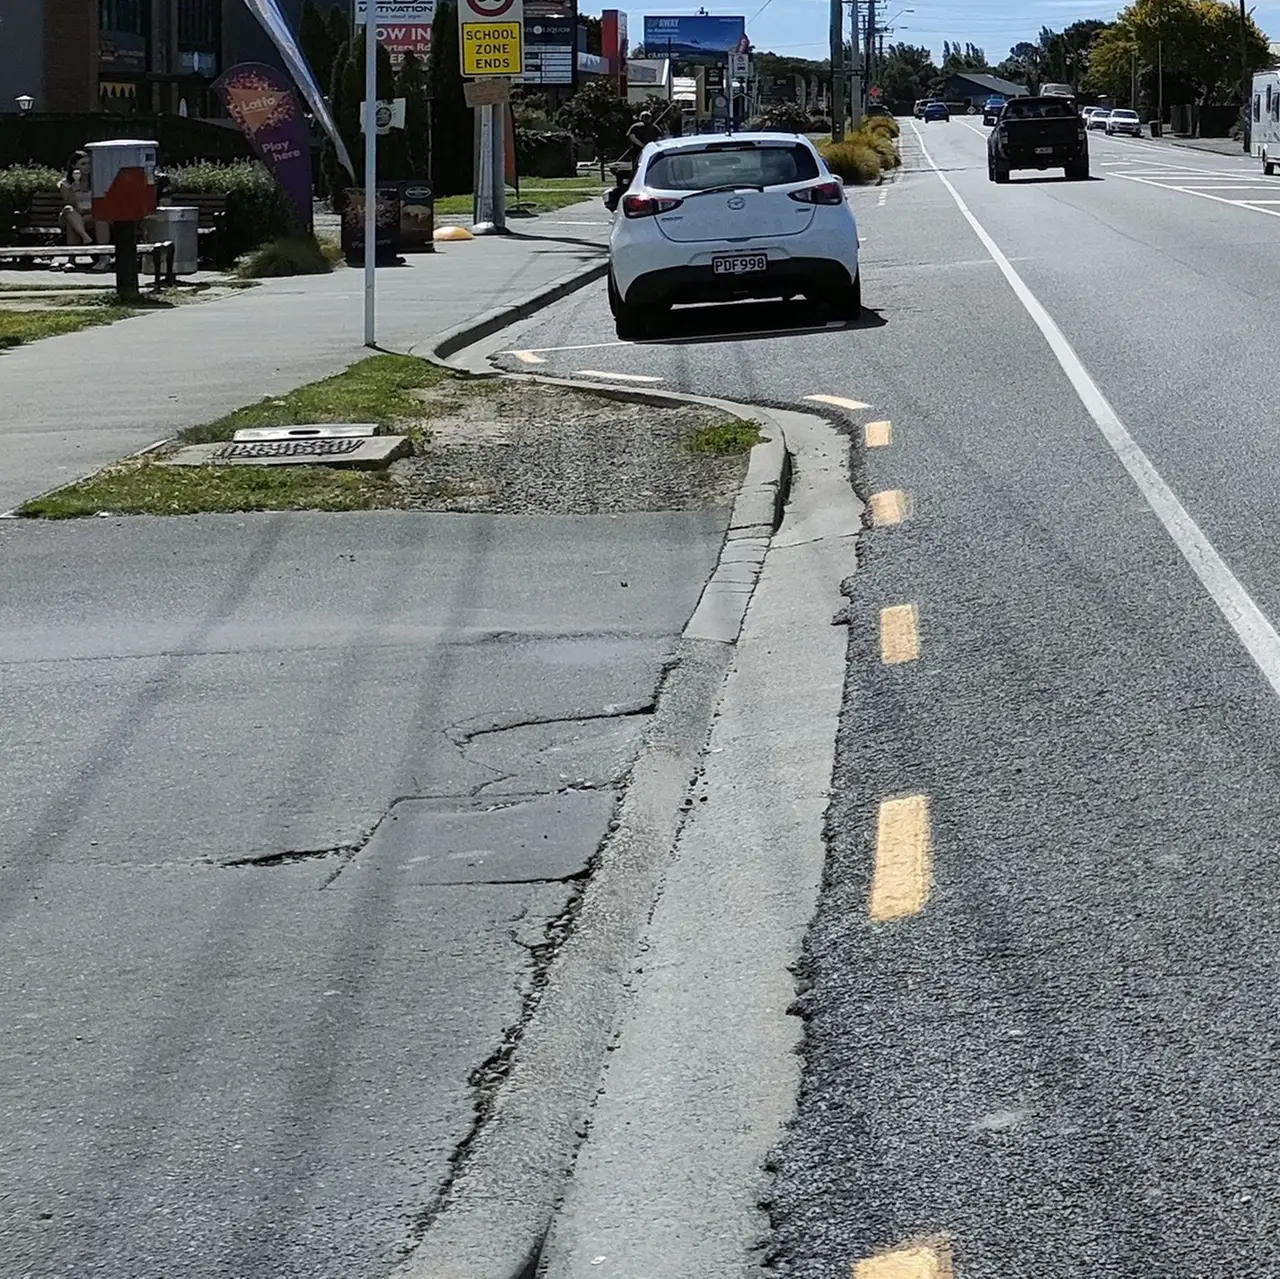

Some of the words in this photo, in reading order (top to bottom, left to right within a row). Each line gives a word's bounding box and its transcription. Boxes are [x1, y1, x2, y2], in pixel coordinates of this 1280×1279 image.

[412, 28, 431, 40] IN
[466, 29, 517, 40] SCHOOL
[417, 42, 431, 51] Rd
[475, 44, 509, 55] ZONE
[475, 58, 510, 69] ENDS
[242, 96, 275, 111] Lotto
[262, 140, 289, 152] Play
[273, 149, 300, 162] here
[715, 257, 765, 272] PDF998
